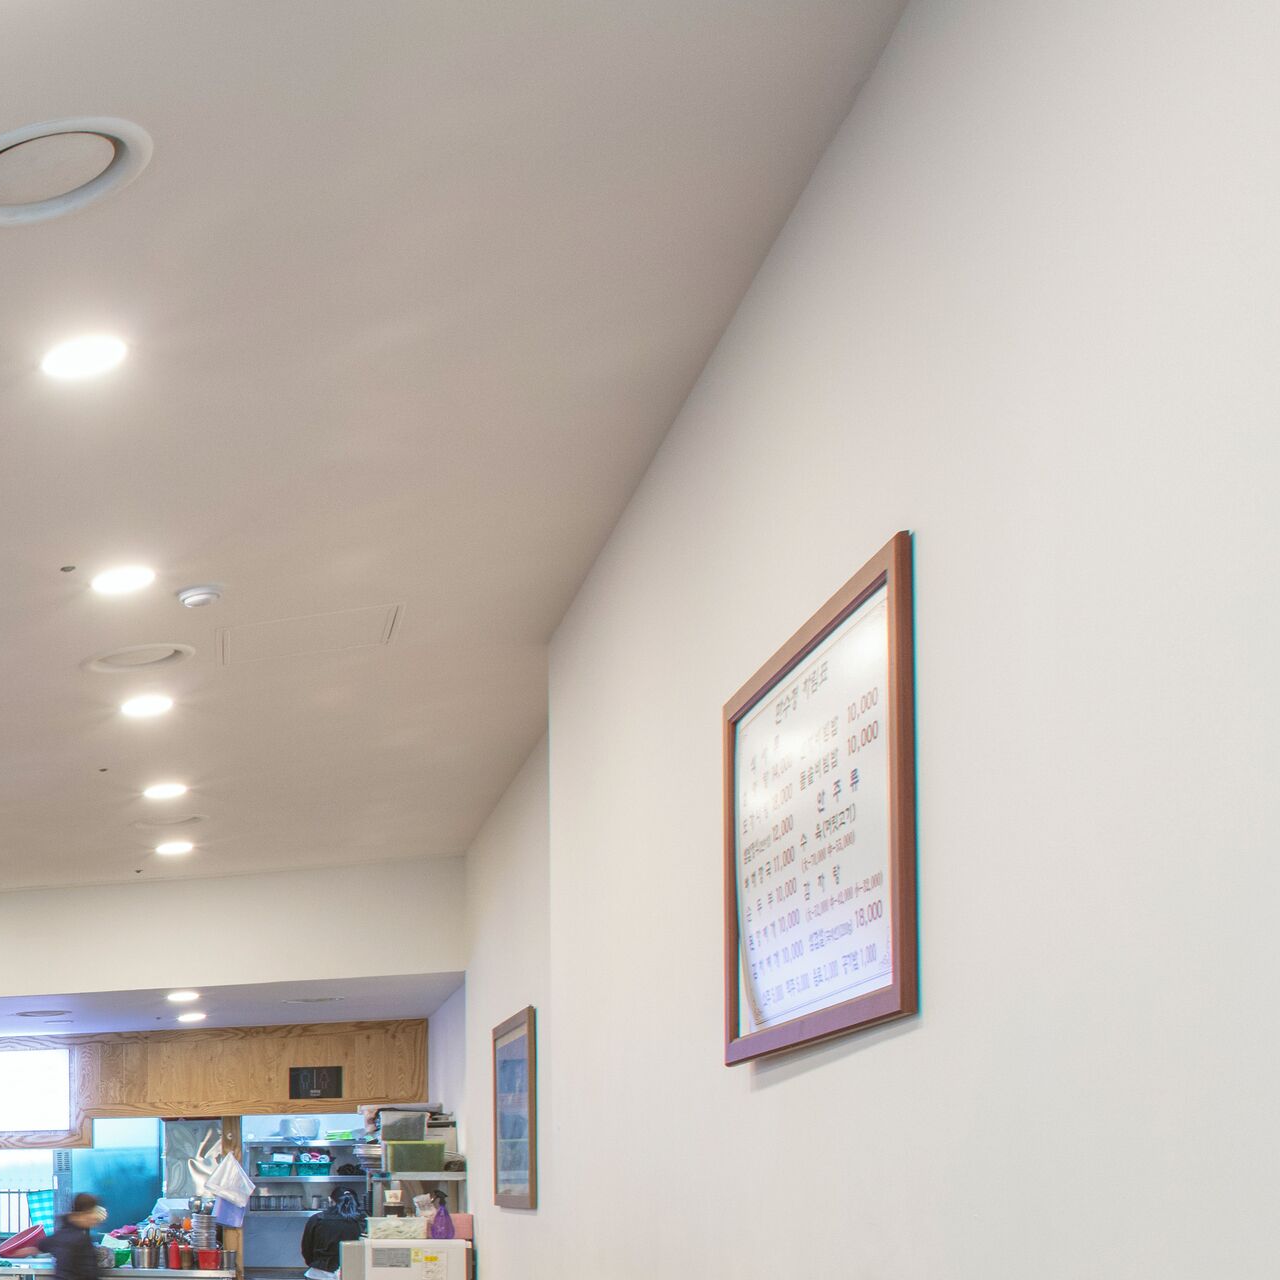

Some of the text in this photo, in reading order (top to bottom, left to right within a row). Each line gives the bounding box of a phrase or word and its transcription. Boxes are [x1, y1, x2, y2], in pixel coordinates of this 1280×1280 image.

[847, 686, 879, 724] 10,000
[847, 720, 879, 756] 10,000
[772, 814, 794, 842] 12,000
[773, 845, 795, 873] 11,000
[778, 908, 800, 934] 10,000
[854, 899, 883, 928] 18,000
